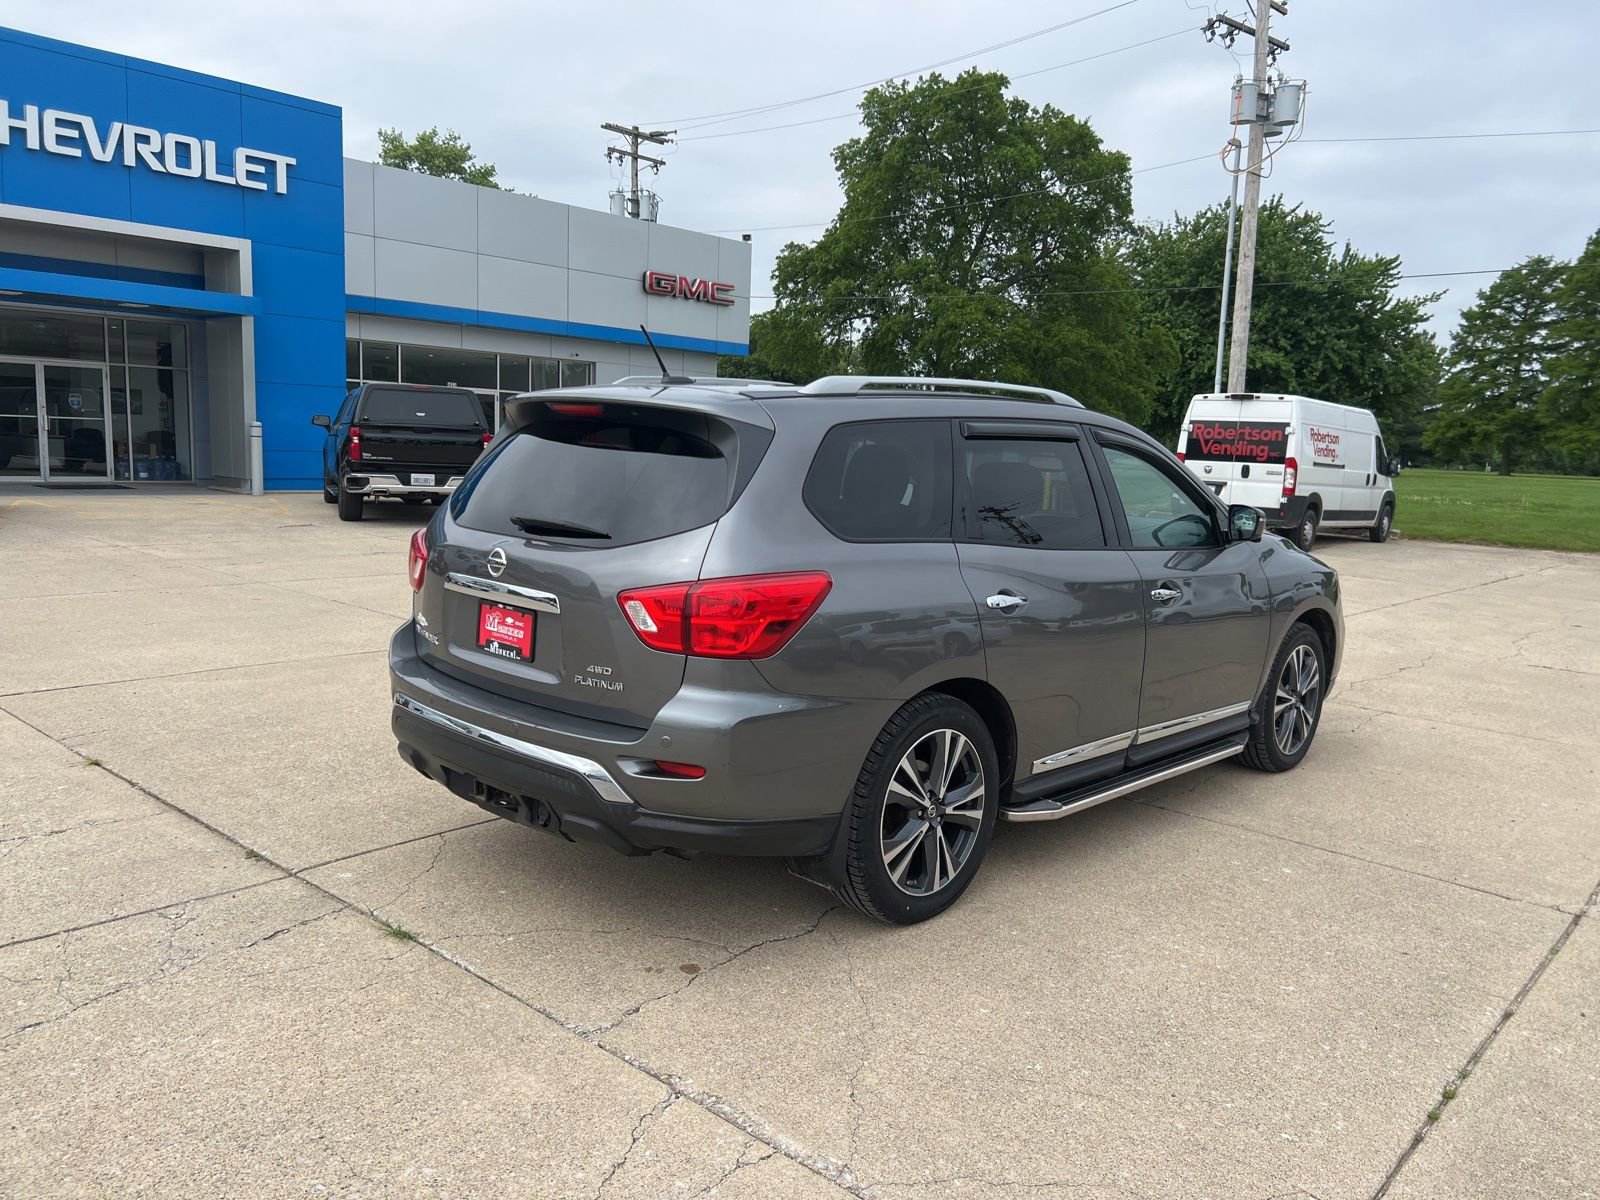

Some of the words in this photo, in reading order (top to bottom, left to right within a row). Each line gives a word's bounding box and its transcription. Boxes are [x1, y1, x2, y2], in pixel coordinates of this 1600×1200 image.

[643, 270, 735, 306] GMC
[1192, 423, 1283, 441] Robertson
[1310, 427, 1340, 445] Robertson
[1199, 438, 1269, 461] Vending
[1312, 442, 1336, 462] Vending
[586, 665, 612, 675] 4WD
[574, 674, 624, 692] PLATINUM
